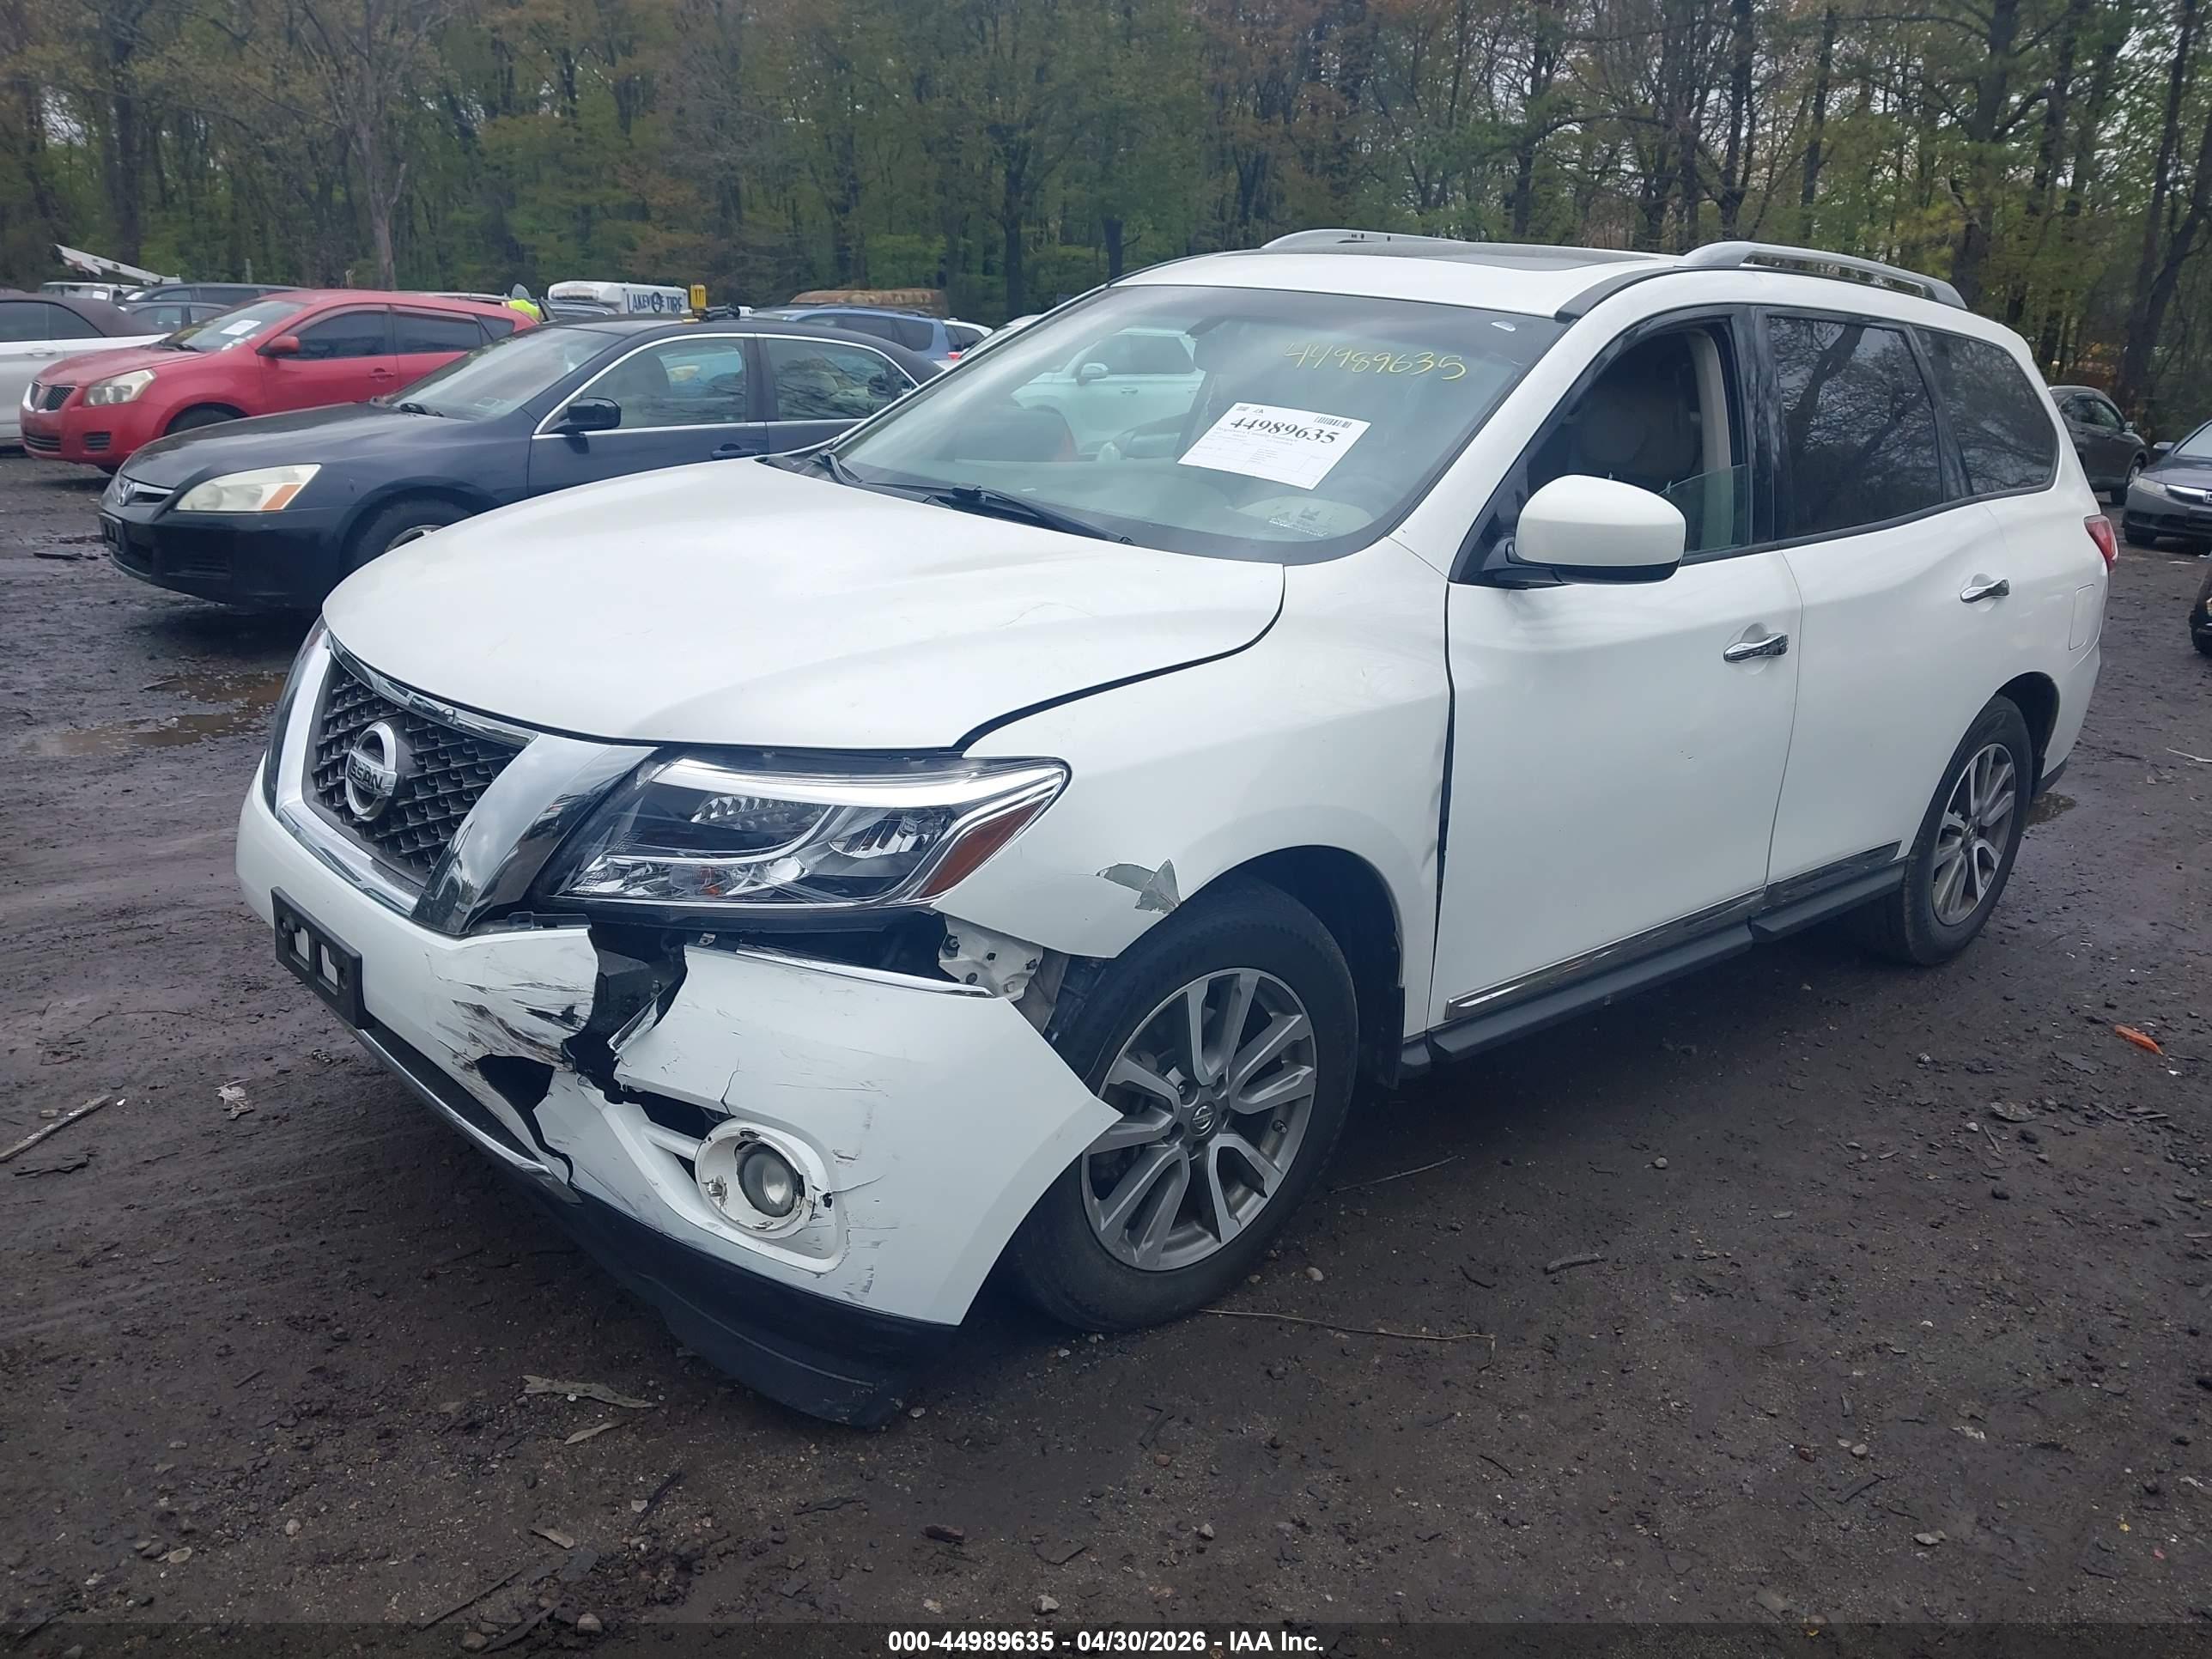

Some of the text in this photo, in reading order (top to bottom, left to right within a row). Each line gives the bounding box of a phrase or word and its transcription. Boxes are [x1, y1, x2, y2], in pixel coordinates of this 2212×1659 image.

[1284, 343, 1467, 380] 44989635
[1231, 417, 1340, 444] 44989635
[350, 760, 384, 790] SSAN
